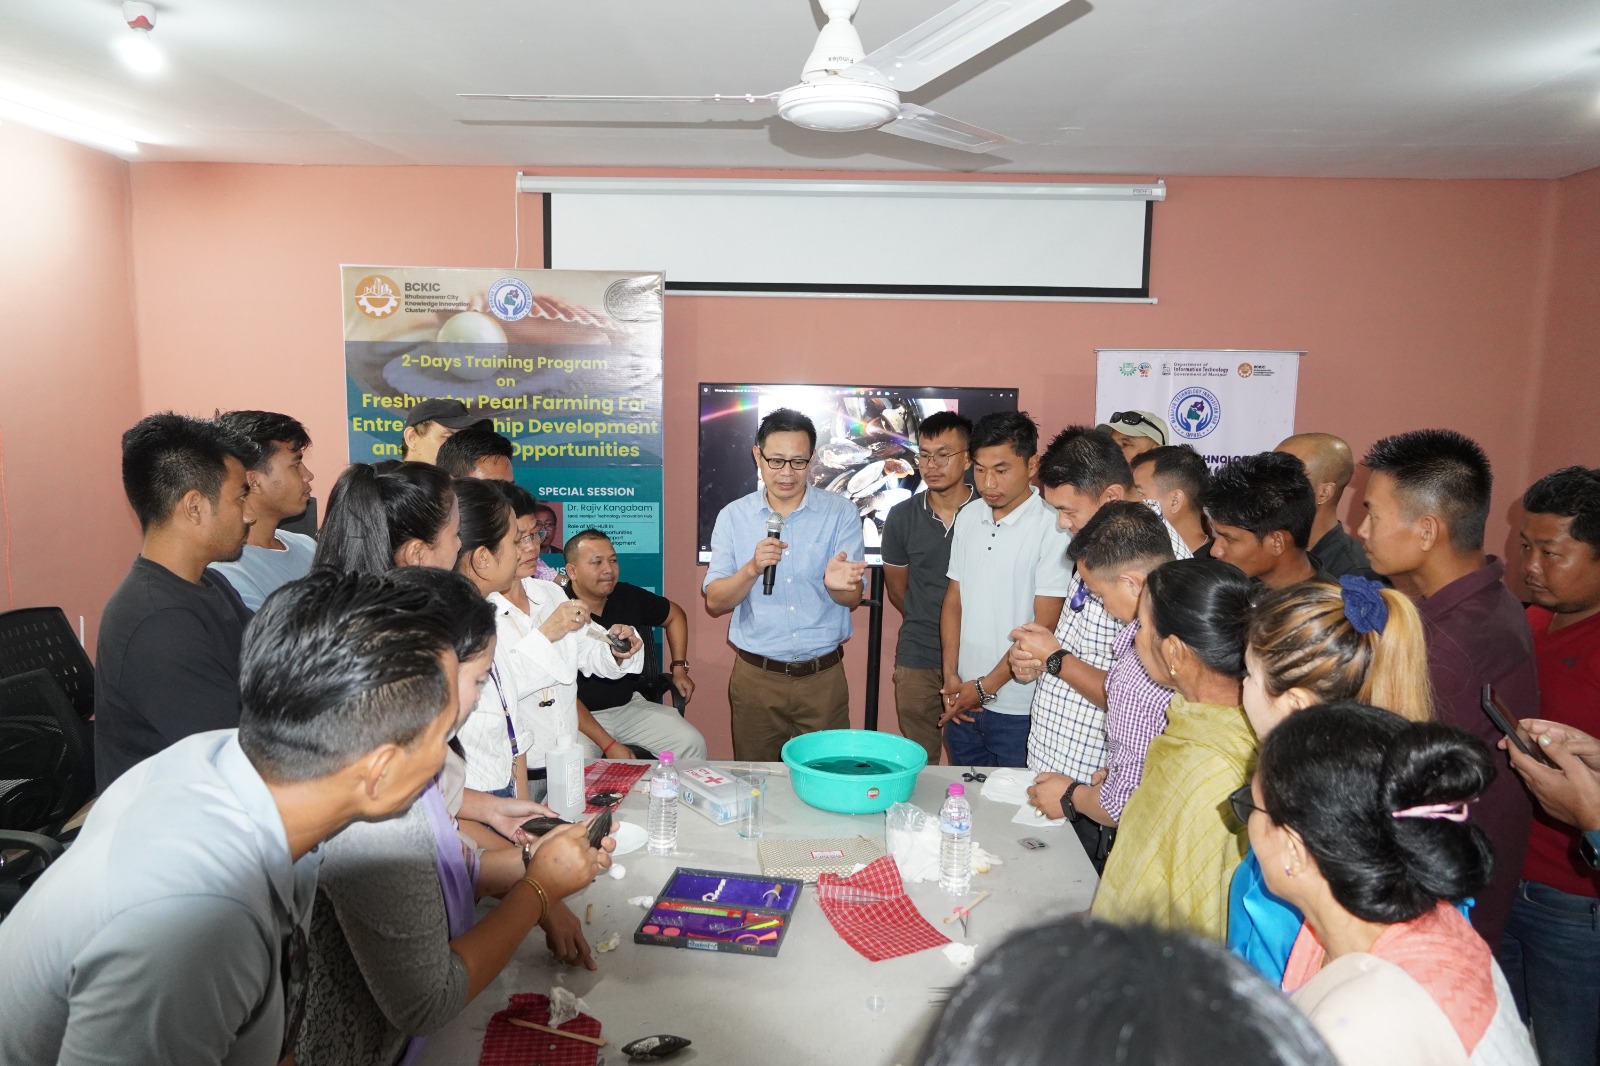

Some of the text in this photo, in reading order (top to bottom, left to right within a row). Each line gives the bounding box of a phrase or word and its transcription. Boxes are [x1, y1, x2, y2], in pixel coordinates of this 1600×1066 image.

[404, 282, 440, 292] BCKIC
[402, 354, 608, 373] 2-Days Training Program
[496, 377, 516, 387] on
[478, 394, 527, 410] Pearl
[533, 394, 614, 415] Farming
[619, 396, 648, 411] For
[529, 418, 658, 438] Development
[511, 442, 640, 461] Opportunities
[538, 487, 634, 496] SPECIAL SESSION
[580, 504, 601, 513] Rajiv
[604, 504, 652, 513] Kangabam
